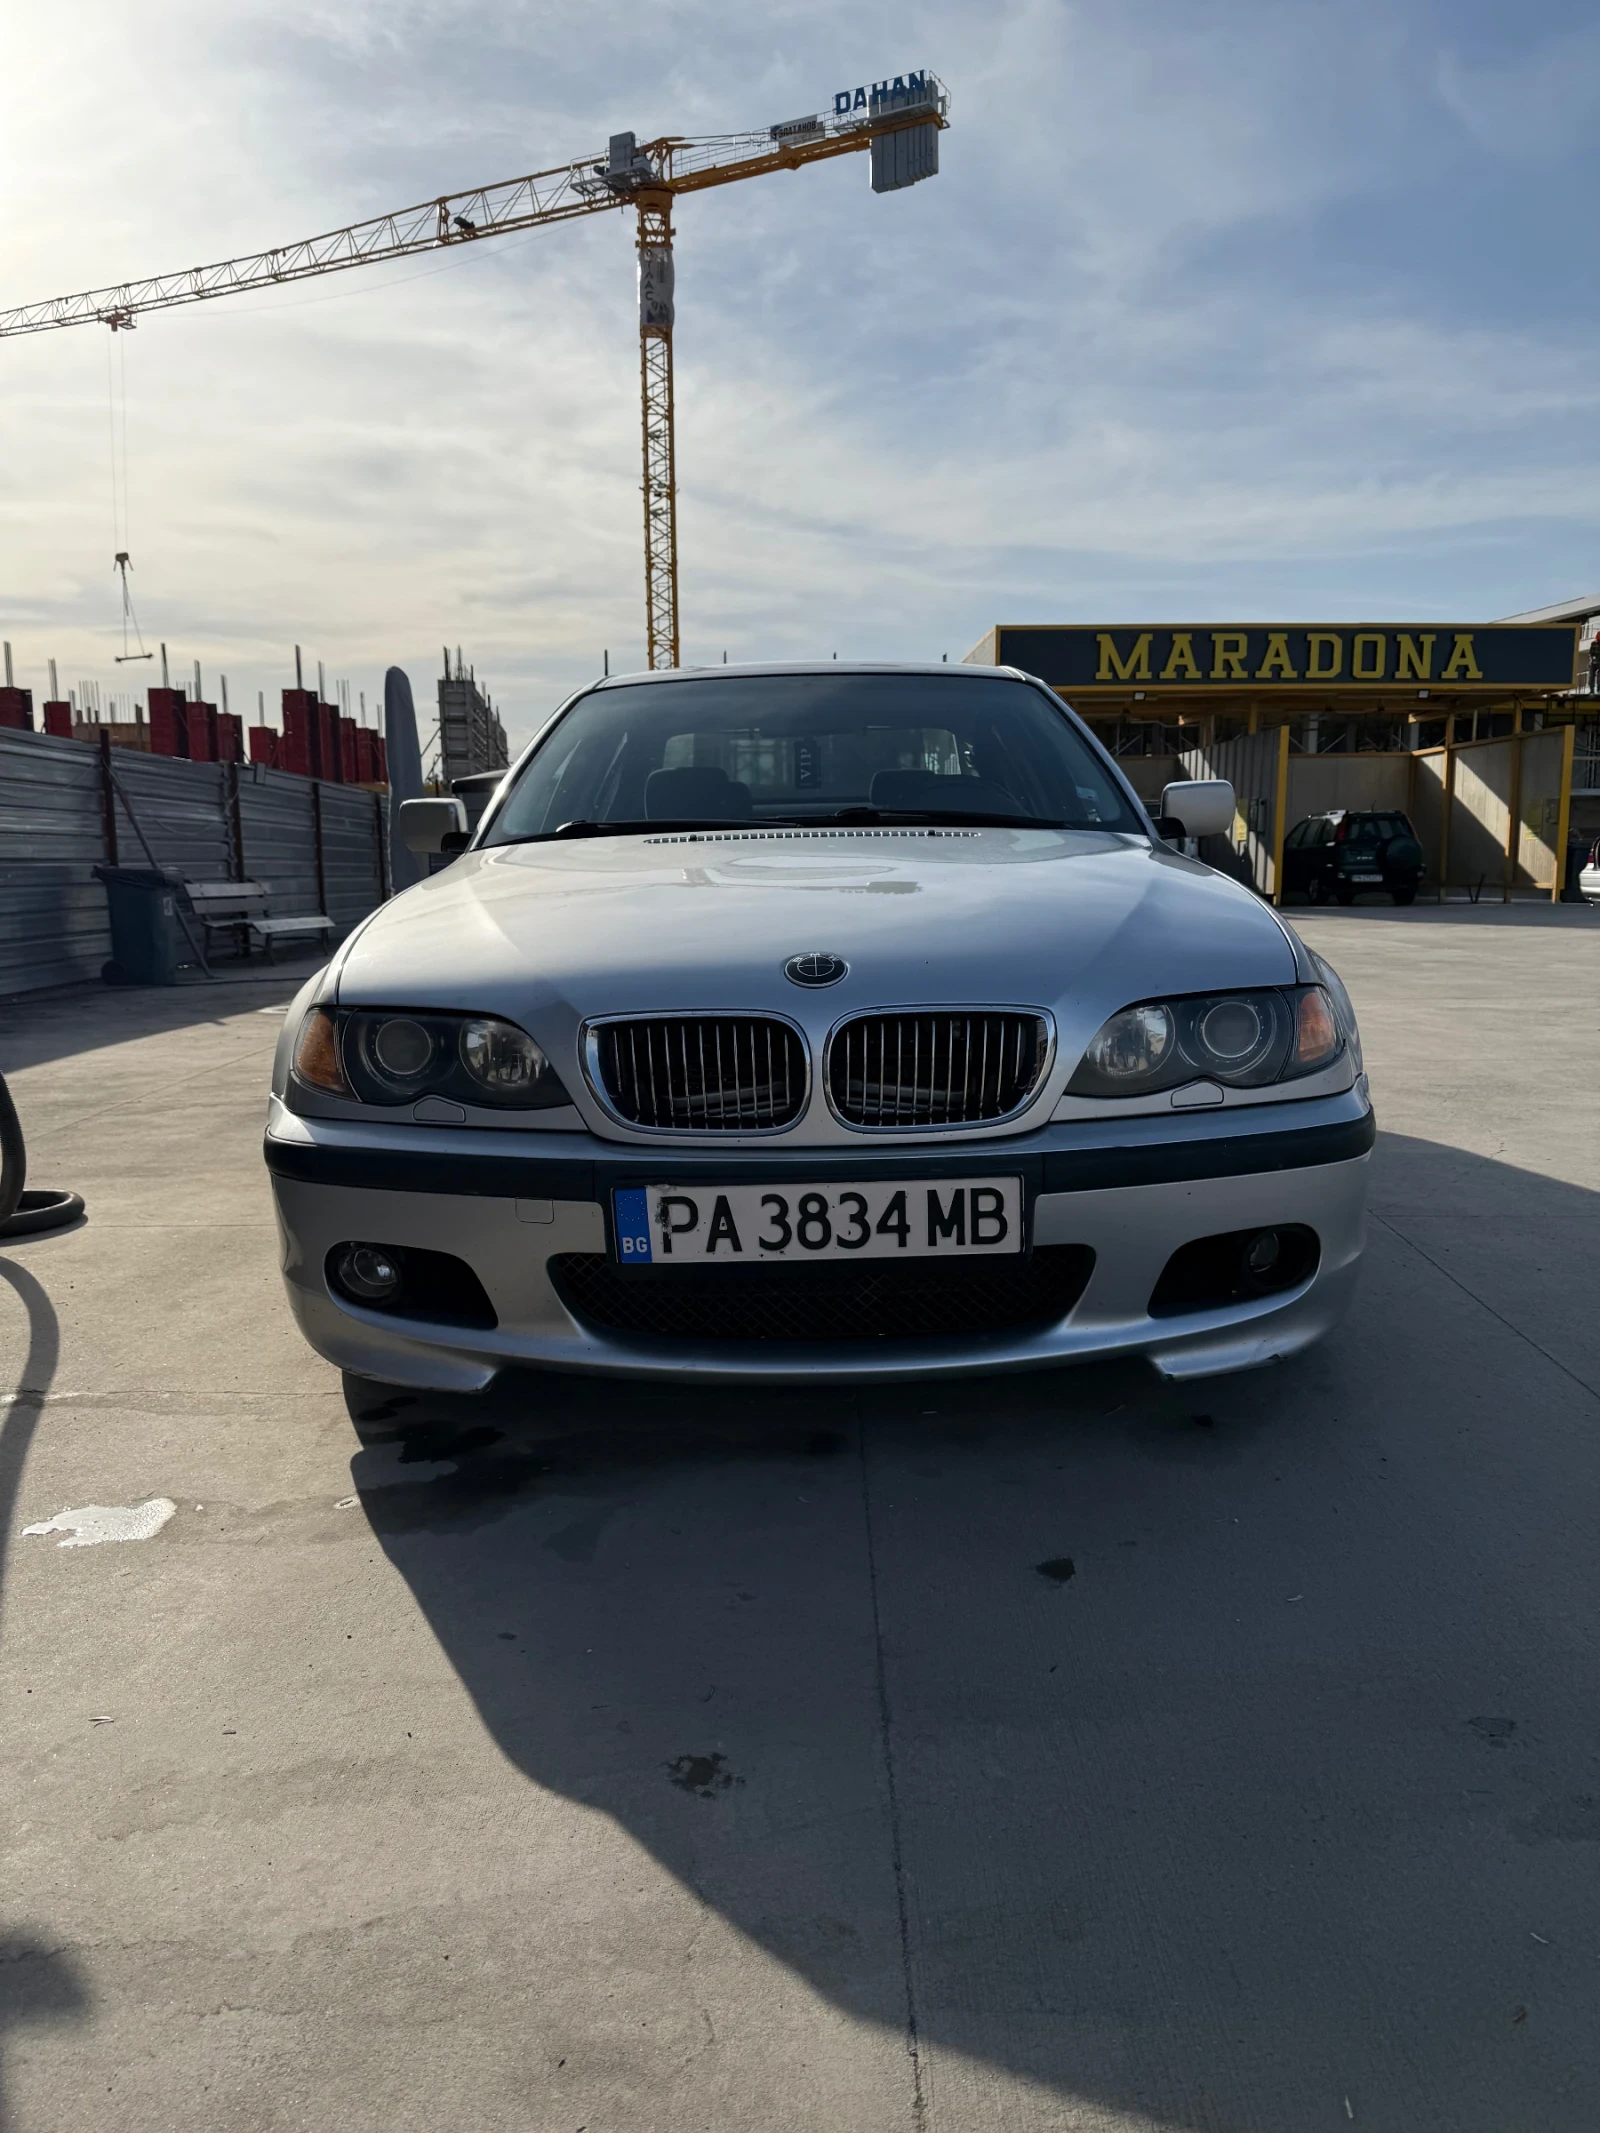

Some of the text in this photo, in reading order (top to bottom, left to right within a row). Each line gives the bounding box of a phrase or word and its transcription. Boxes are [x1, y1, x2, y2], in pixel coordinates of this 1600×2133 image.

[835, 69, 925, 115] DAHAN
[1095, 632, 1483, 680] MARADONA
[800, 748, 812, 780] VIP
[660, 1187, 1008, 1254] PA 3834 MB
[622, 1237, 648, 1254] BG
